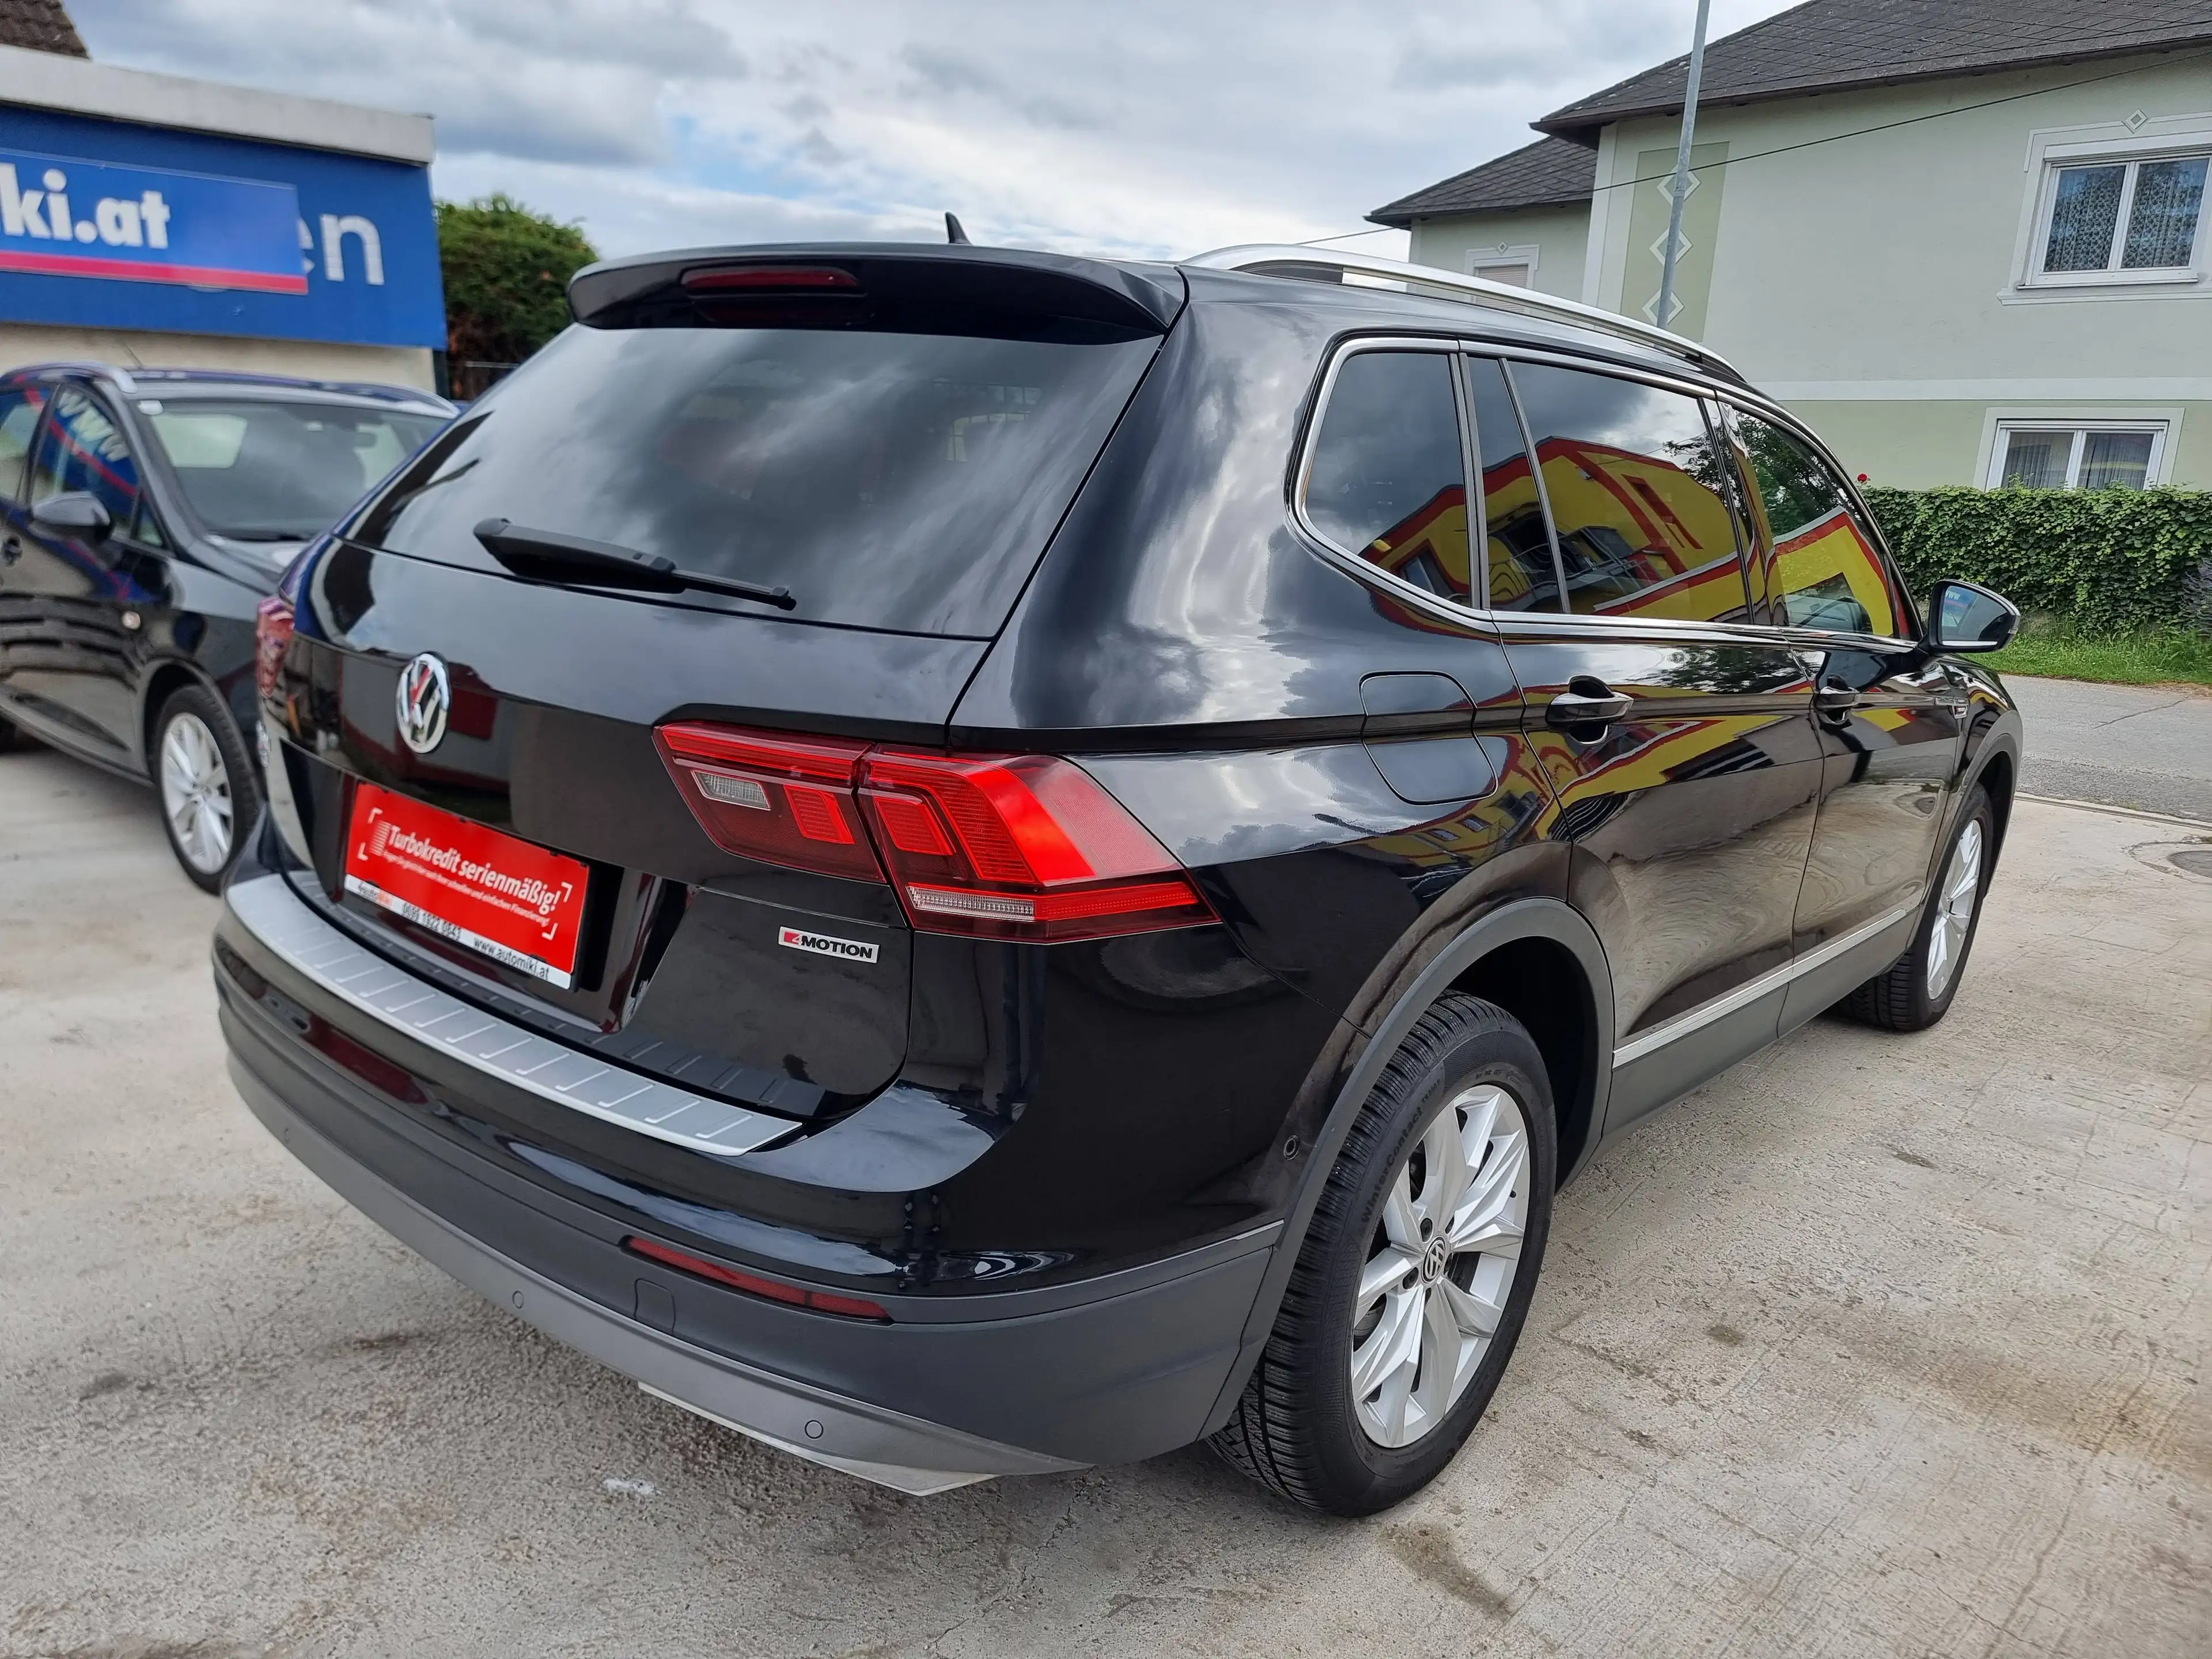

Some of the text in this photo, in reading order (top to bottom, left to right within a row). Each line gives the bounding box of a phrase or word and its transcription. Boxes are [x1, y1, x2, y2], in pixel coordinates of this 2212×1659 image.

[388, 825, 461, 873] Turbokredit
[458, 860, 561, 915] serienmäßig!
[474, 938, 549, 980] www.automiki.at
[786, 931, 872, 959] 4MOTION
